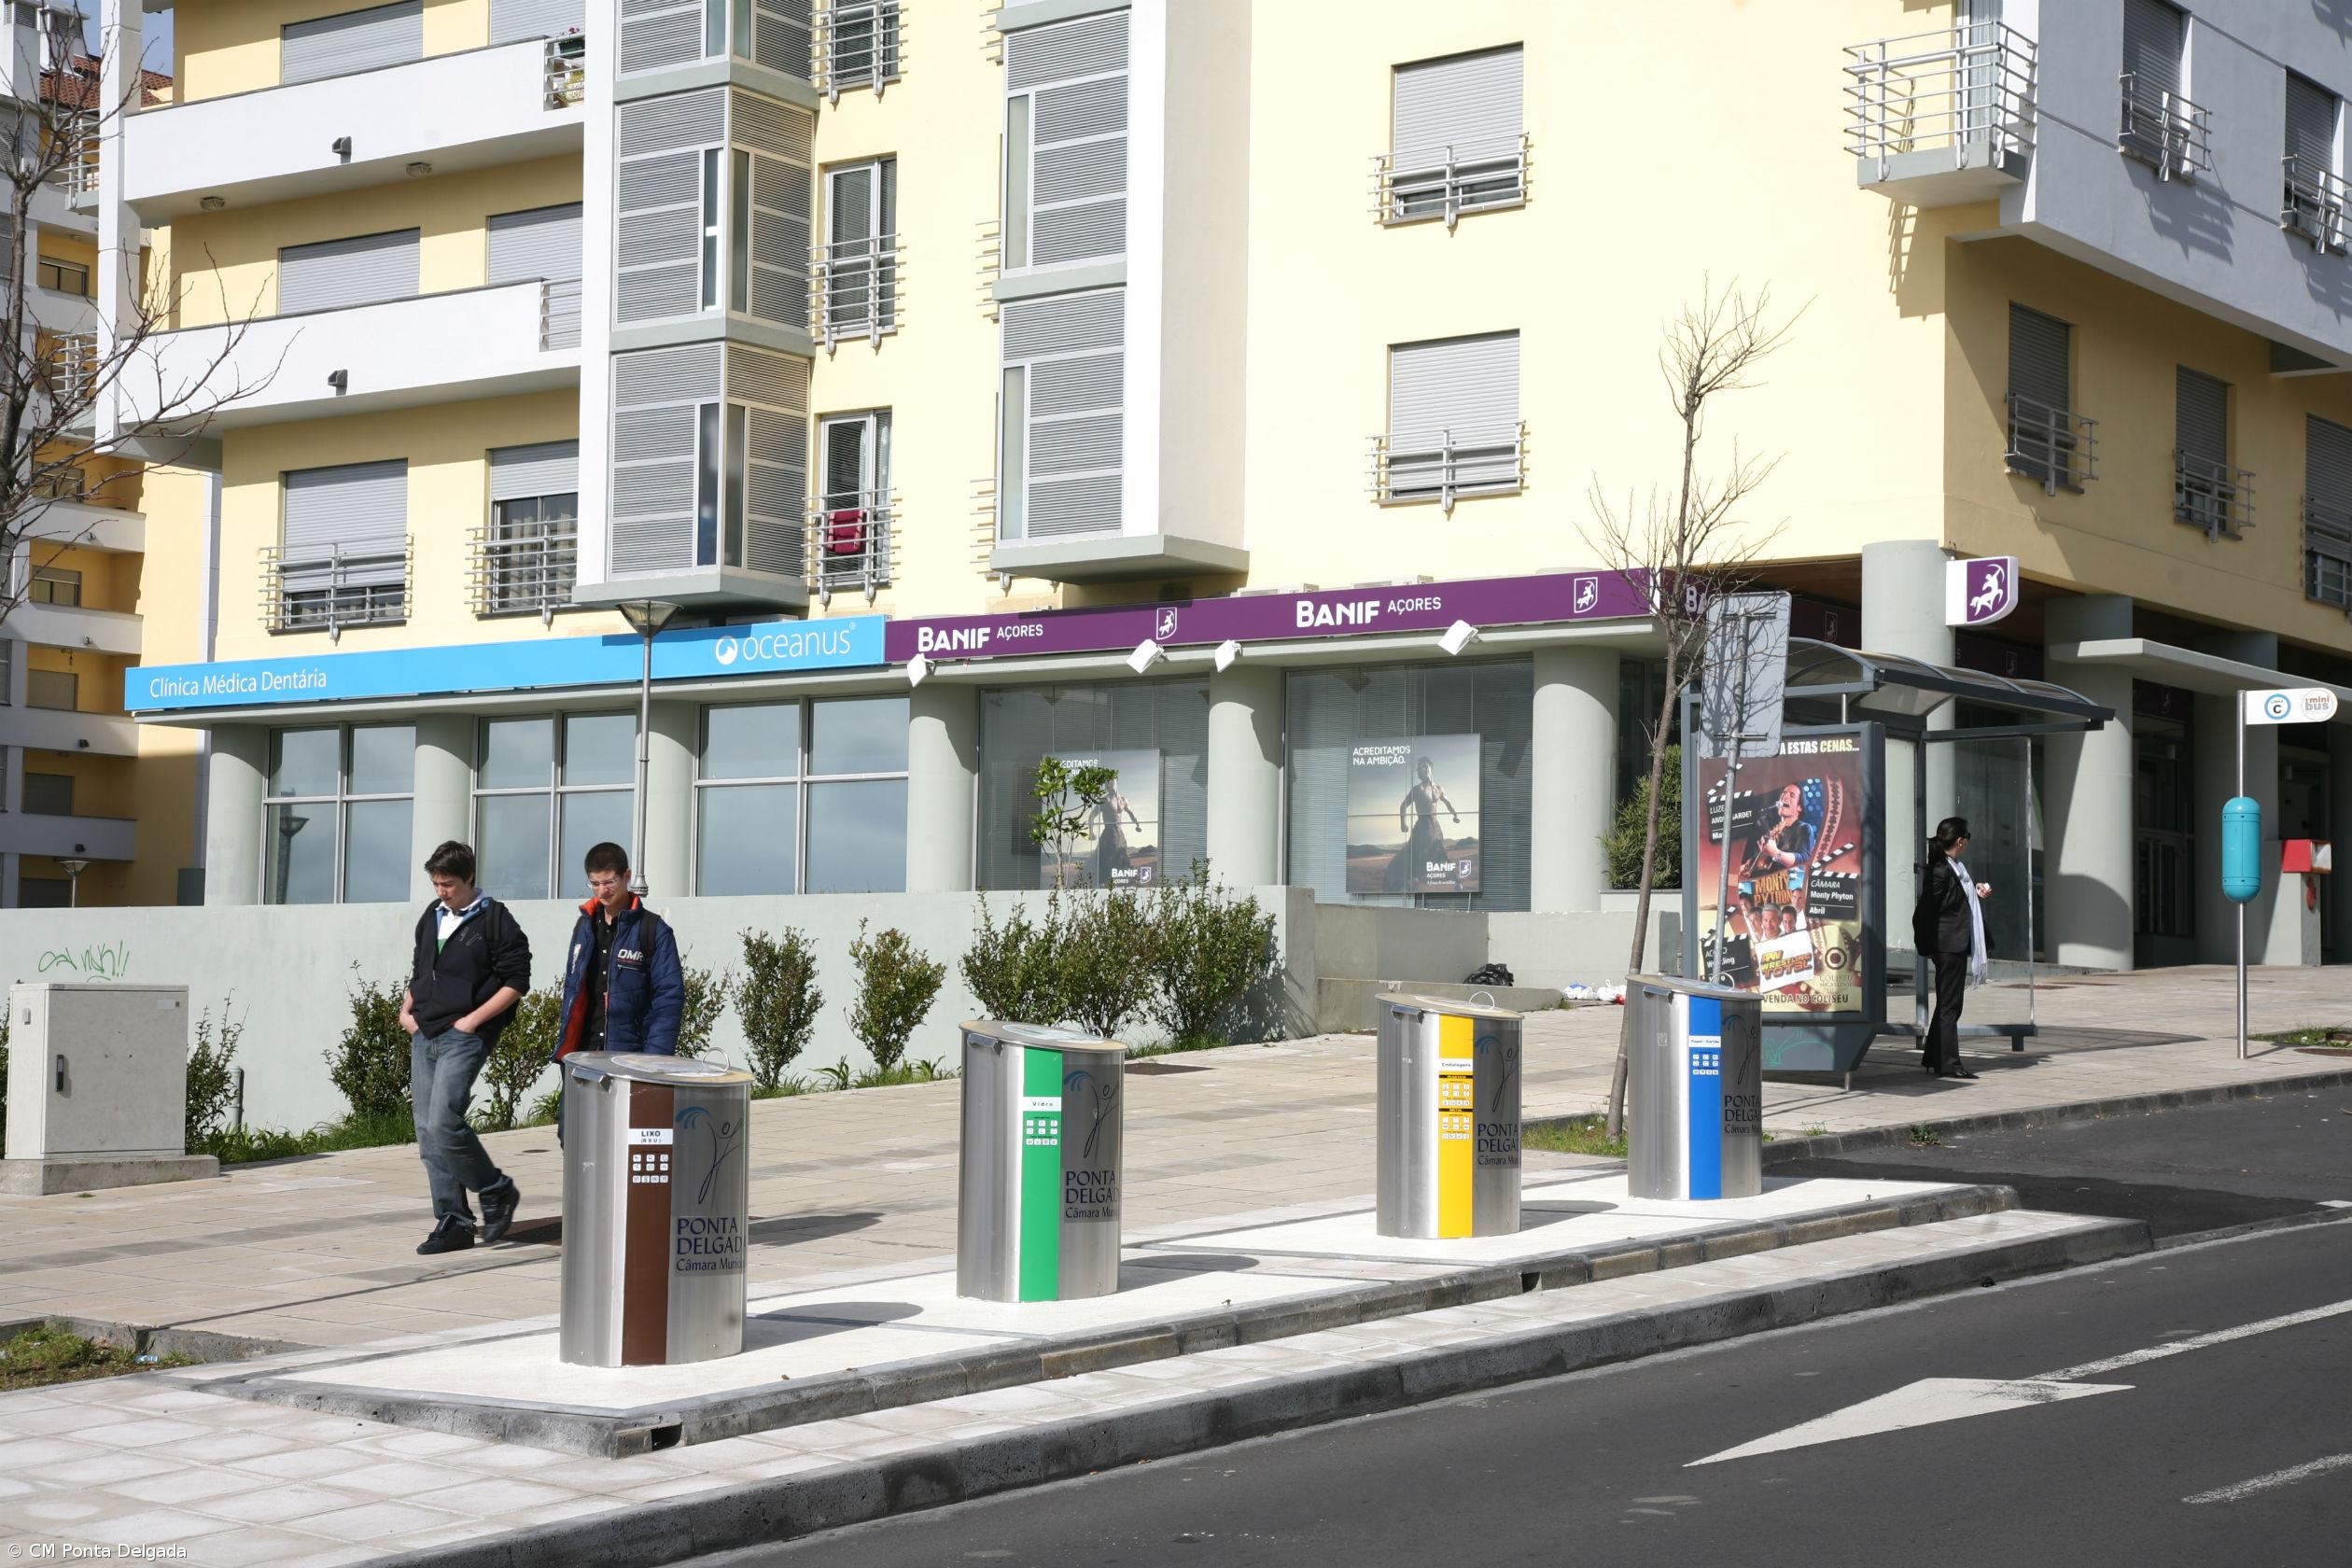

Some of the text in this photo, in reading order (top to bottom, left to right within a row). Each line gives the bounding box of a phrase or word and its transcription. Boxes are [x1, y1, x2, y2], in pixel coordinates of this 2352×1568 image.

[1296, 596, 1442, 628] BANIF AÇORES
[917, 623, 1044, 652] BANIF AÇORES
[149, 667, 328, 698] Clínica Médica Dentária
[2273, 704, 2283, 714] C
[2304, 701, 2331, 711] bus
[1352, 745, 1411, 756] ACREDITAMOS
[1787, 740, 1819, 755] ESTAS
[1820, 738, 1860, 753] CENAS...
[1352, 753, 1407, 766] NA AMBIÇÃO.
[1709, 804, 1726, 815] LUZE
[1426, 861, 1456, 872] BANIF
[1111, 868, 1139, 878] BANIF
[1811, 879, 1841, 889] CÂMARA
[1810, 890, 1854, 902] Monty Phyton
[1809, 905, 1826, 915] Abril
[1763, 994, 1849, 1003] VENDA NO COLISEU
[1065, 1169, 1116, 1186] PONTA
[1065, 1206, 1099, 1219] Câmara
[677, 1216, 738, 1235] PONTA
[676, 1258, 717, 1271] Câmara
